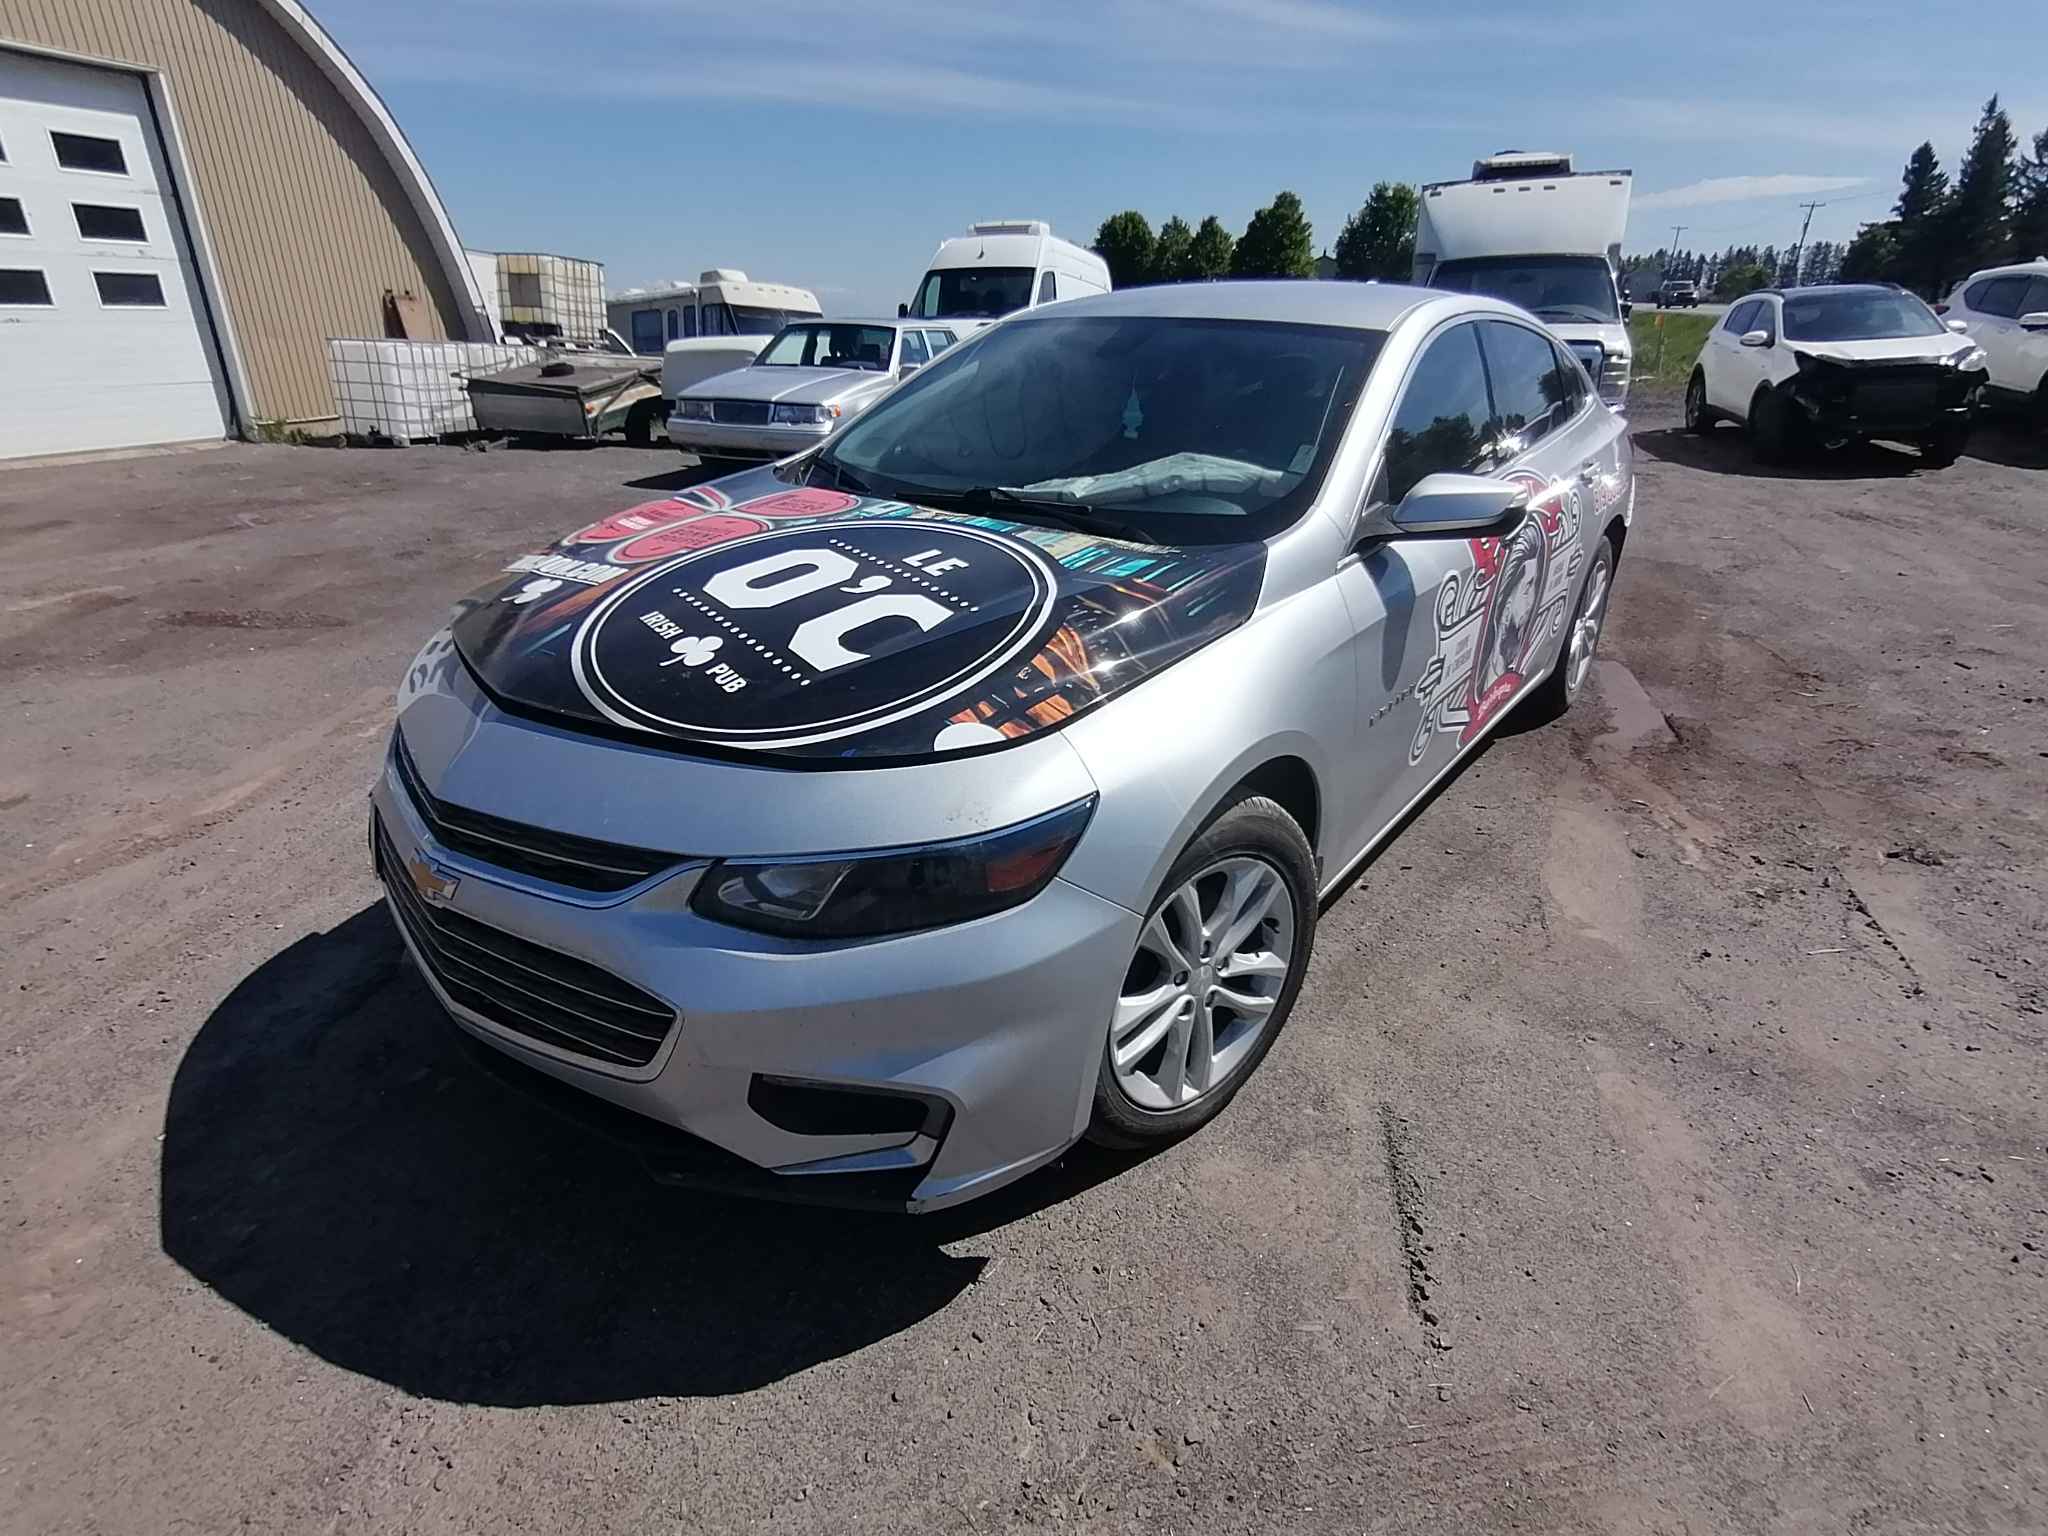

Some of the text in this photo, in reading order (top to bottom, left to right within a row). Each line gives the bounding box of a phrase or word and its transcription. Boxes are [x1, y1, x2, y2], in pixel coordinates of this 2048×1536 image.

[902, 549, 969, 577] LE
[639, 610, 747, 694] IRISH PUB
[702, 548, 955, 672] O'C
